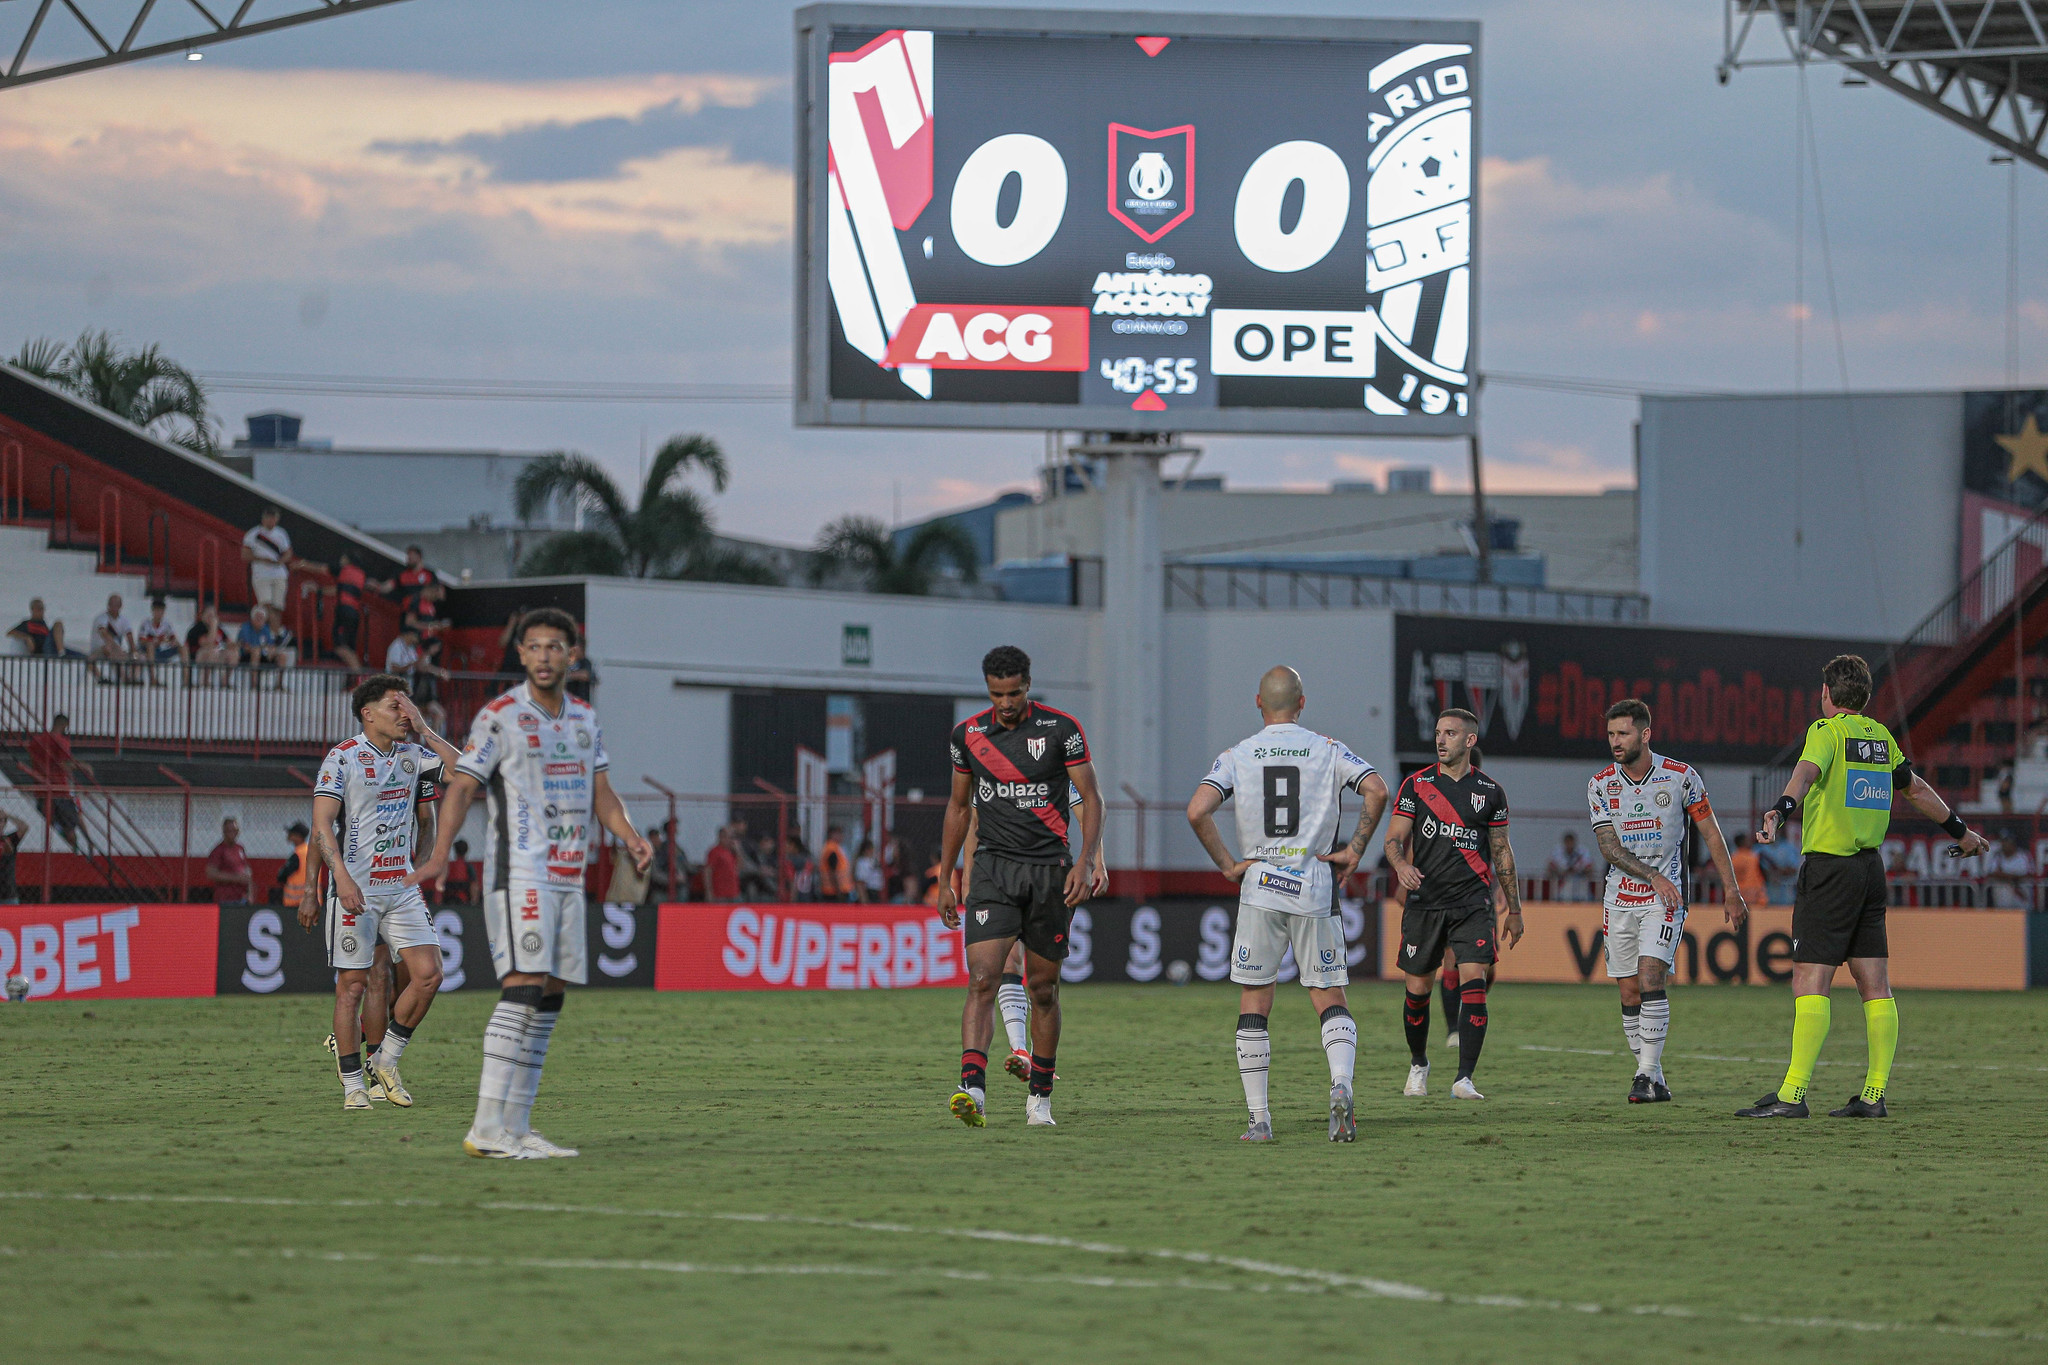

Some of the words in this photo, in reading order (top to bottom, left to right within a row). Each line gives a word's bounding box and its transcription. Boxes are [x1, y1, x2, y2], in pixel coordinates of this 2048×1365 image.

[950, 133, 1069, 266] 0
[1234, 139, 1351, 273] 0
[1092, 292, 1212, 317] ACCIOLY
[915, 312, 1053, 363] ACG
[1234, 323, 1353, 362] OPE
[1101, 357, 1198, 394] 40:55
[1269, 747, 1310, 758] Sicredi
[543, 779, 586, 791] PHILIPS
[996, 782, 1048, 798] blaze
[1858, 785, 1889, 800] Midea
[1016, 798, 1048, 809] .bet.br
[1263, 766, 1300, 838] 8
[347, 817, 360, 864] PROADEC
[1440, 822, 1478, 840] blaze
[1622, 832, 1663, 844] PHILIPS
[1452, 840, 1478, 851] .bet.br
[1268, 878, 1300, 892] JOELINI
[1660, 924, 1673, 944] 10
[1566, 922, 1795, 983] vnde
